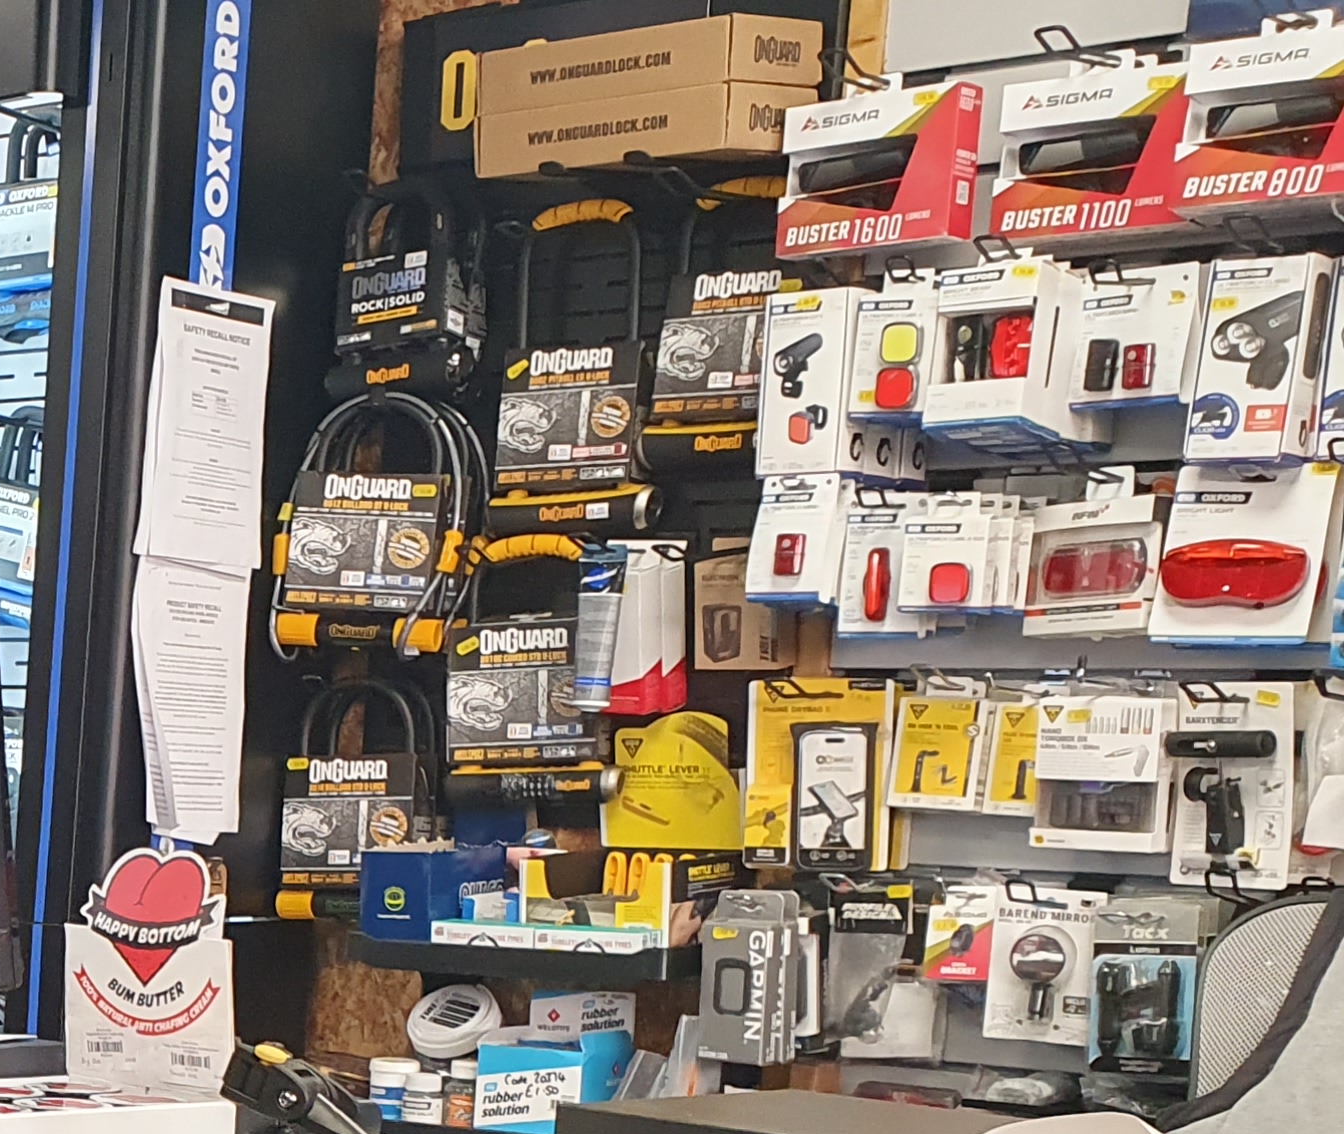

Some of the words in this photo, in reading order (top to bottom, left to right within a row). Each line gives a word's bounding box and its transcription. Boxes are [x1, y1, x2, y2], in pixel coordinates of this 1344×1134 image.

[529, 51, 671, 85] WWW.ONGUARDLOCK.COM
[1237, 47, 1309, 68] SIGMA
[204, 0, 240, 218] OXFORD
[1046, 88, 1113, 108] SIGMA
[528, 114, 668, 145] WWW.ONGUARDLOCK.COM
[821, 109, 880, 129] SIGMA
[1183, 171, 1264, 198] BUSTER
[1267, 164, 1325, 197] 800
[1001, 204, 1076, 231] BUSTER
[1078, 199, 1132, 229] 1100
[785, 219, 850, 247] BUSTER
[853, 212, 903, 244] 1600
[694, 270, 783, 300] ONGUARD
[529, 347, 613, 376] ONGUARD
[324, 474, 412, 500] ONGUARD
[1201, 493, 1246, 503] OXFORD
[480, 628, 568, 655] ONGUARD
[309, 758, 388, 783] ONGUARD
[93, 911, 138, 943] HAPPY
[138, 917, 202, 945] BOTTOM
[999, 907, 1047, 920] BAREND
[1050, 911, 1095, 924] MIRRO
[1123, 925, 1169, 940] Tacx
[107, 978, 135, 1004] BUM
[137, 981, 185, 1008] BUTTER
[580, 1019, 625, 1033] solution
[581, 1007, 619, 1022] rubber
[481, 1104, 530, 1118] solution
[482, 1092, 523, 1105] rubber
